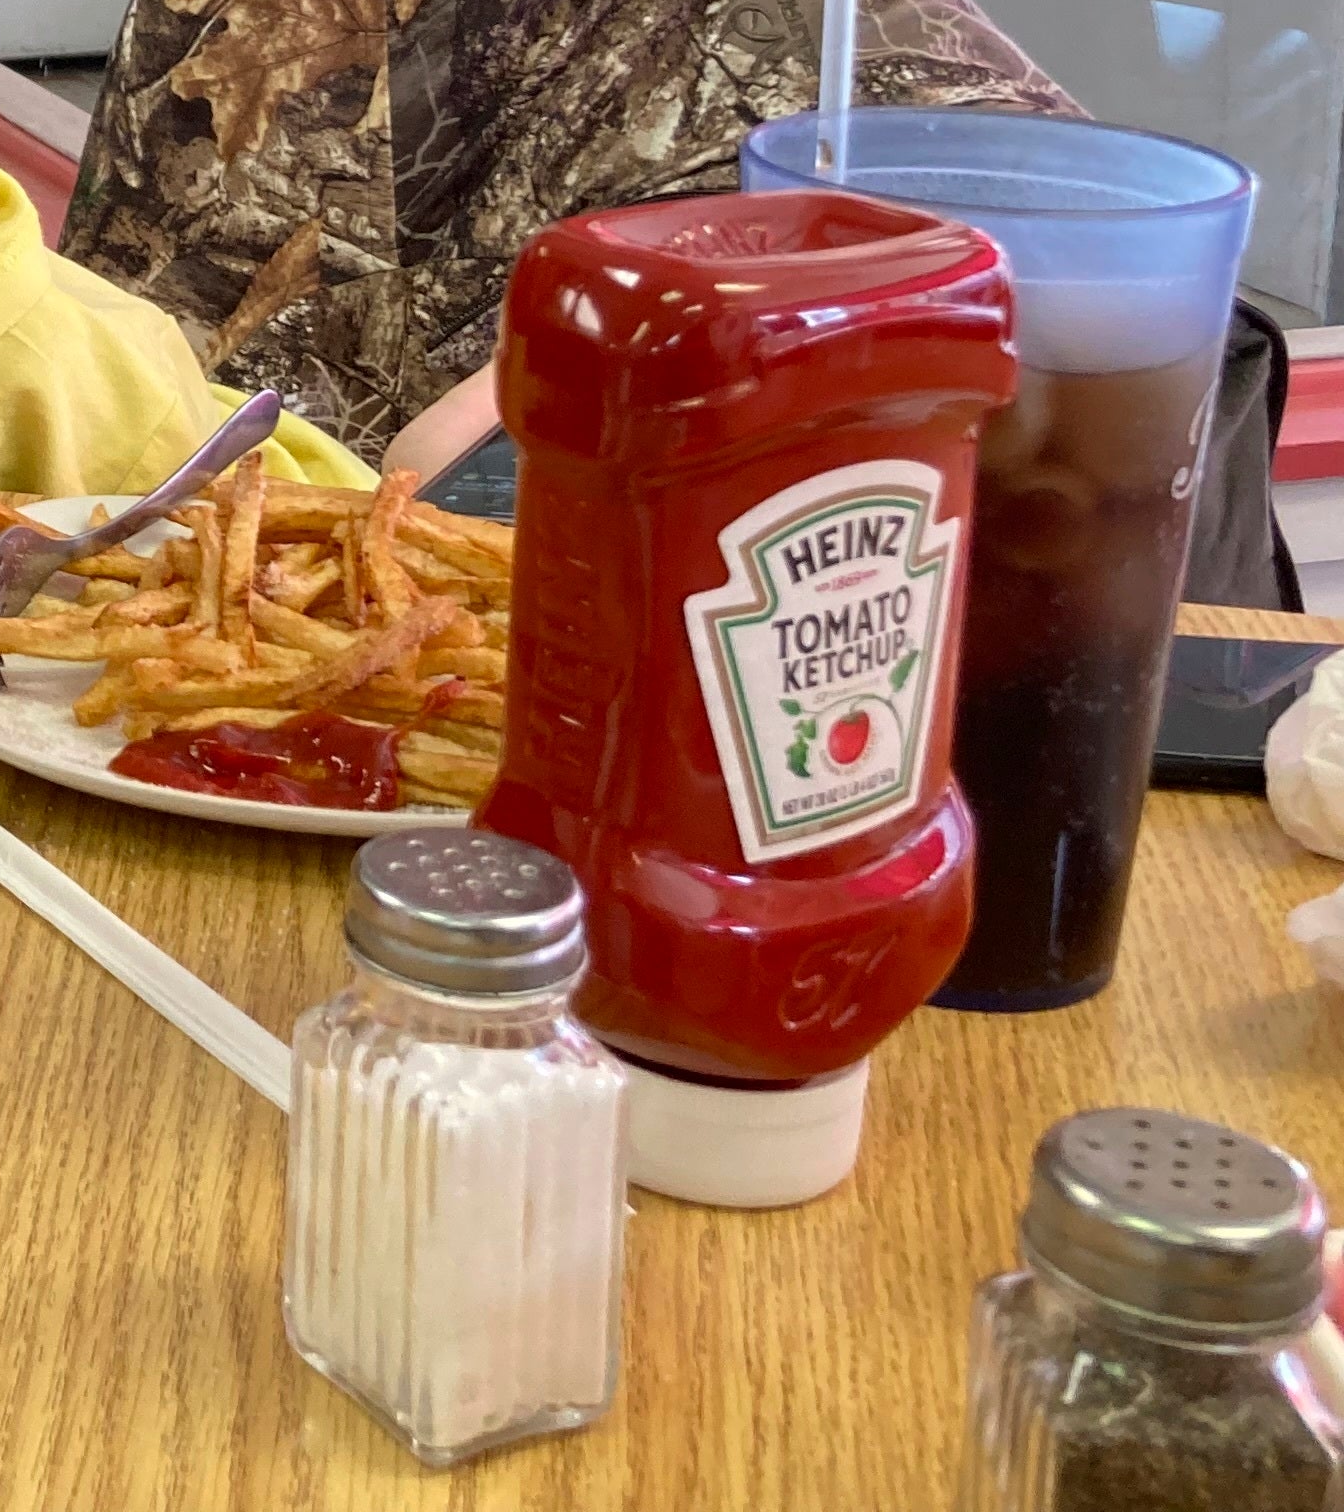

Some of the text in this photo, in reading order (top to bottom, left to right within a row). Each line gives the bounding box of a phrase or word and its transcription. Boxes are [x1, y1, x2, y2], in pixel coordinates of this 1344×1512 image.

[781, 515, 904, 584] HEINZ
[772, 585, 911, 659] TOMATO
[783, 629, 905, 693] KETCHUP
